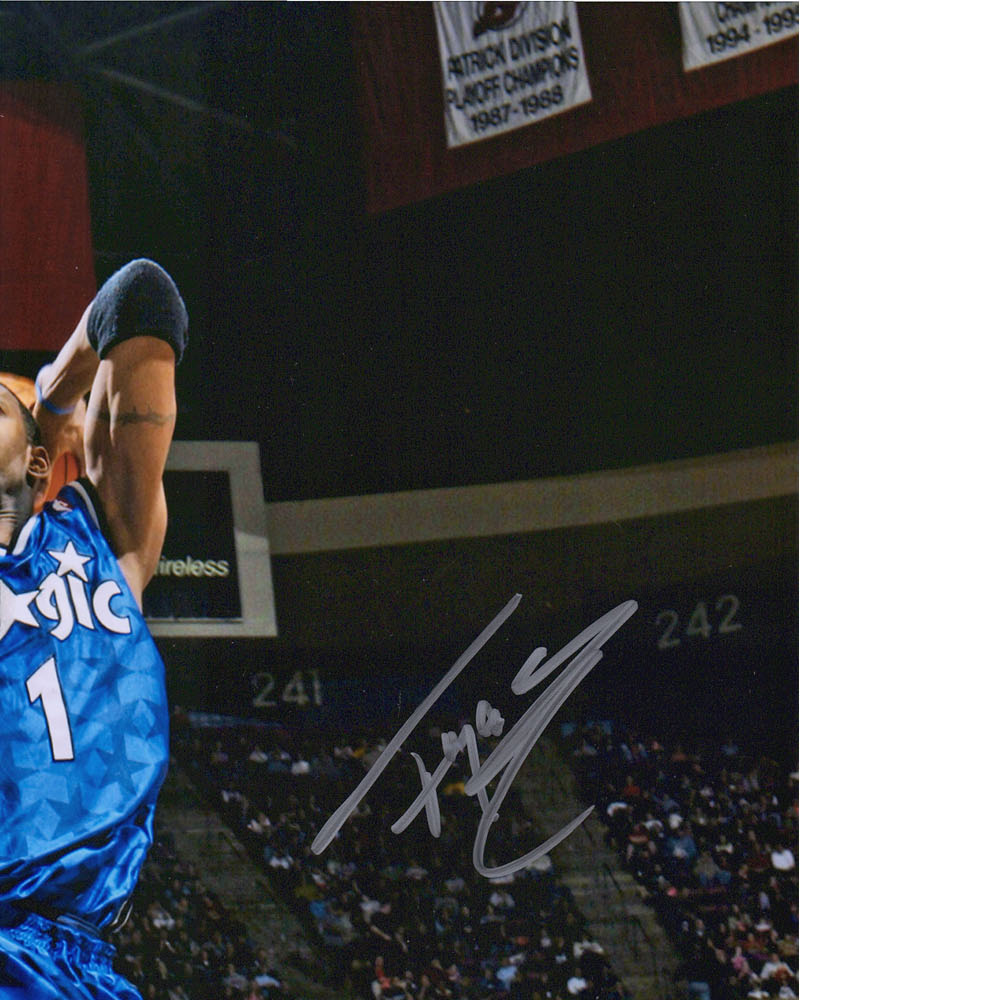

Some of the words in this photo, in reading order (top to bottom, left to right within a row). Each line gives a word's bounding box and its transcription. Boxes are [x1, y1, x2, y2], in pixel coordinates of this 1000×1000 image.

[448, 42, 506, 80] PATRICK
[508, 17, 572, 61] DIVISION
[446, 75, 501, 110] PLAYOFF
[504, 46, 579, 94] CHAMPIONS
[154, 555, 229, 577] ireless
[655, 595, 743, 649] 242
[26, 655, 75, 762] 1
[251, 670, 325, 707] 241
